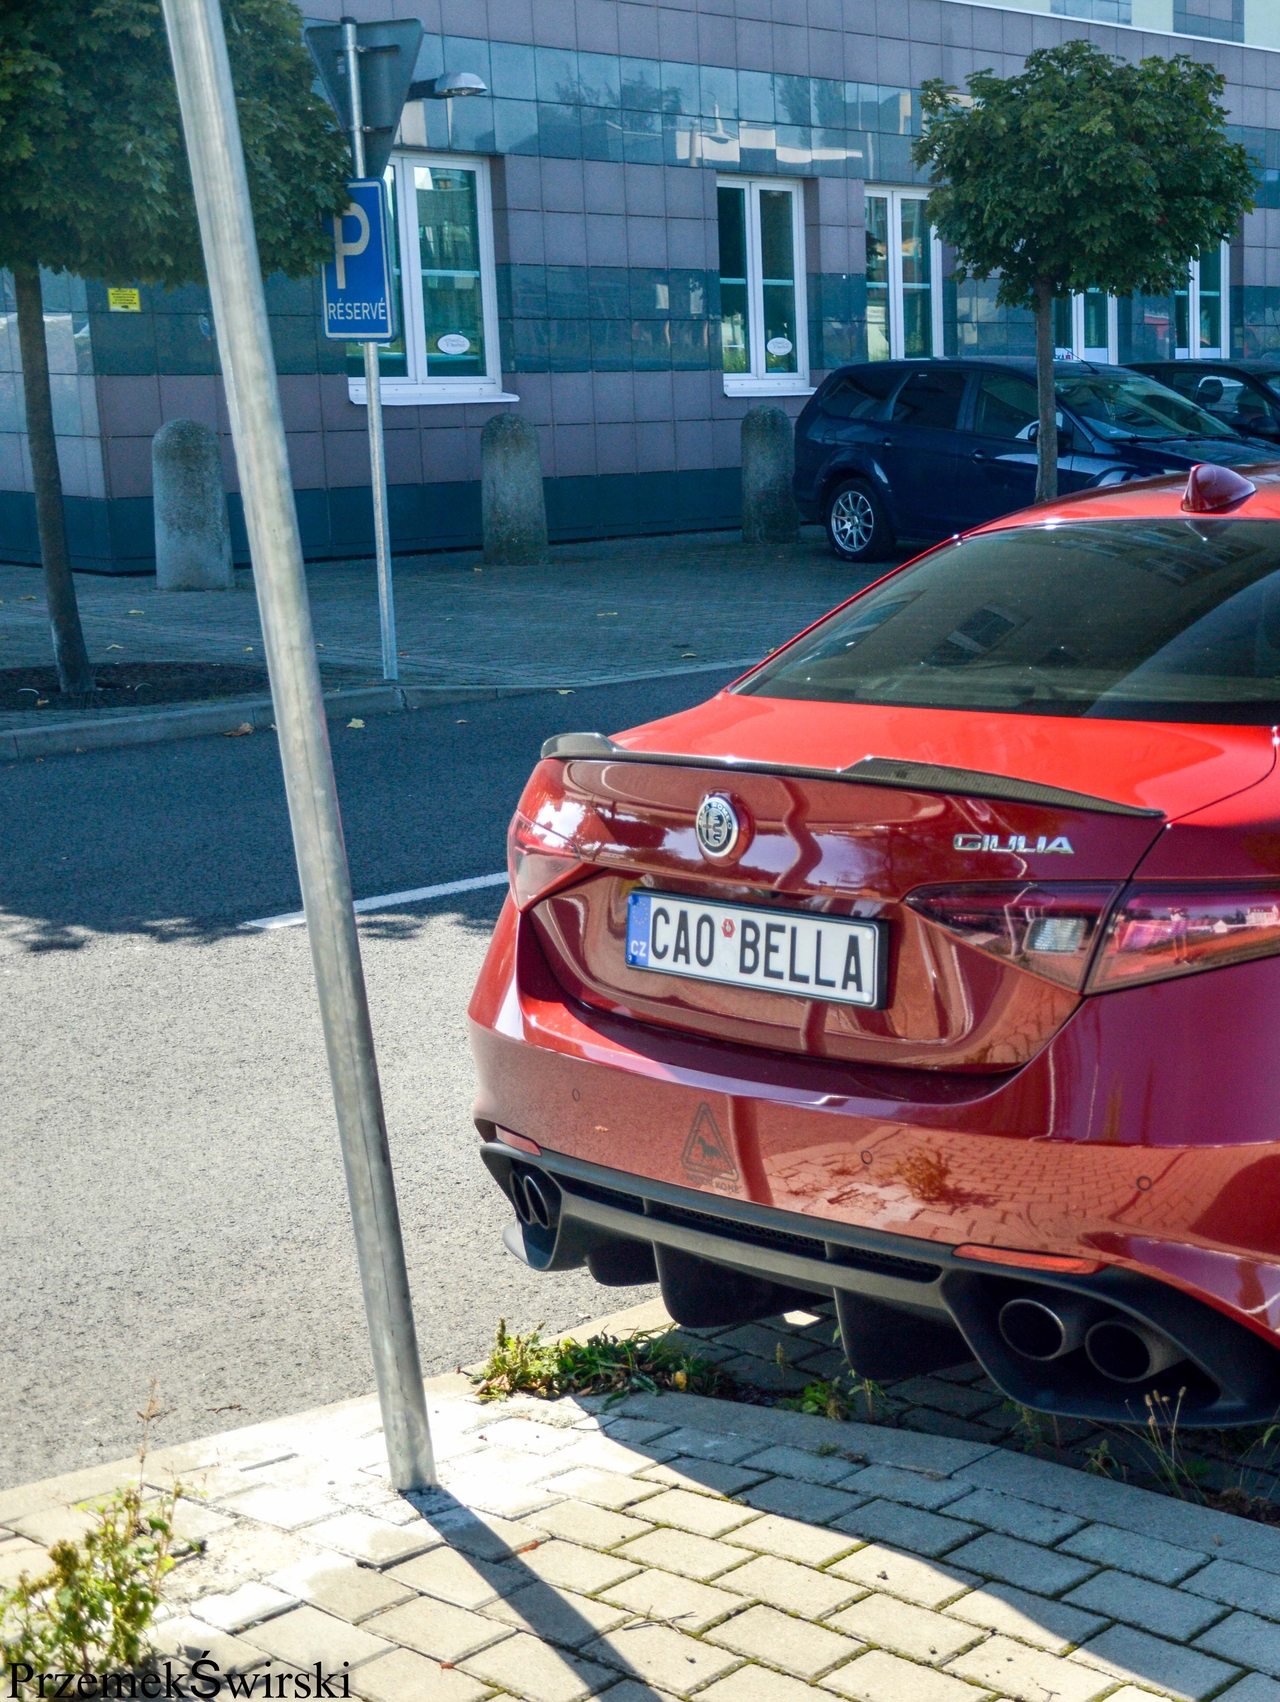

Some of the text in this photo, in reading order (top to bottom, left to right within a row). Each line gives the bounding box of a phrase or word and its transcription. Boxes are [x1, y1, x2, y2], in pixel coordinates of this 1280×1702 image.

[333, 202, 370, 289] P
[328, 297, 387, 320] RÉSERVÉ
[953, 833, 1075, 854] GIULIA
[630, 940, 647, 957] CZ
[651, 907, 864, 993] CAO BELLA
